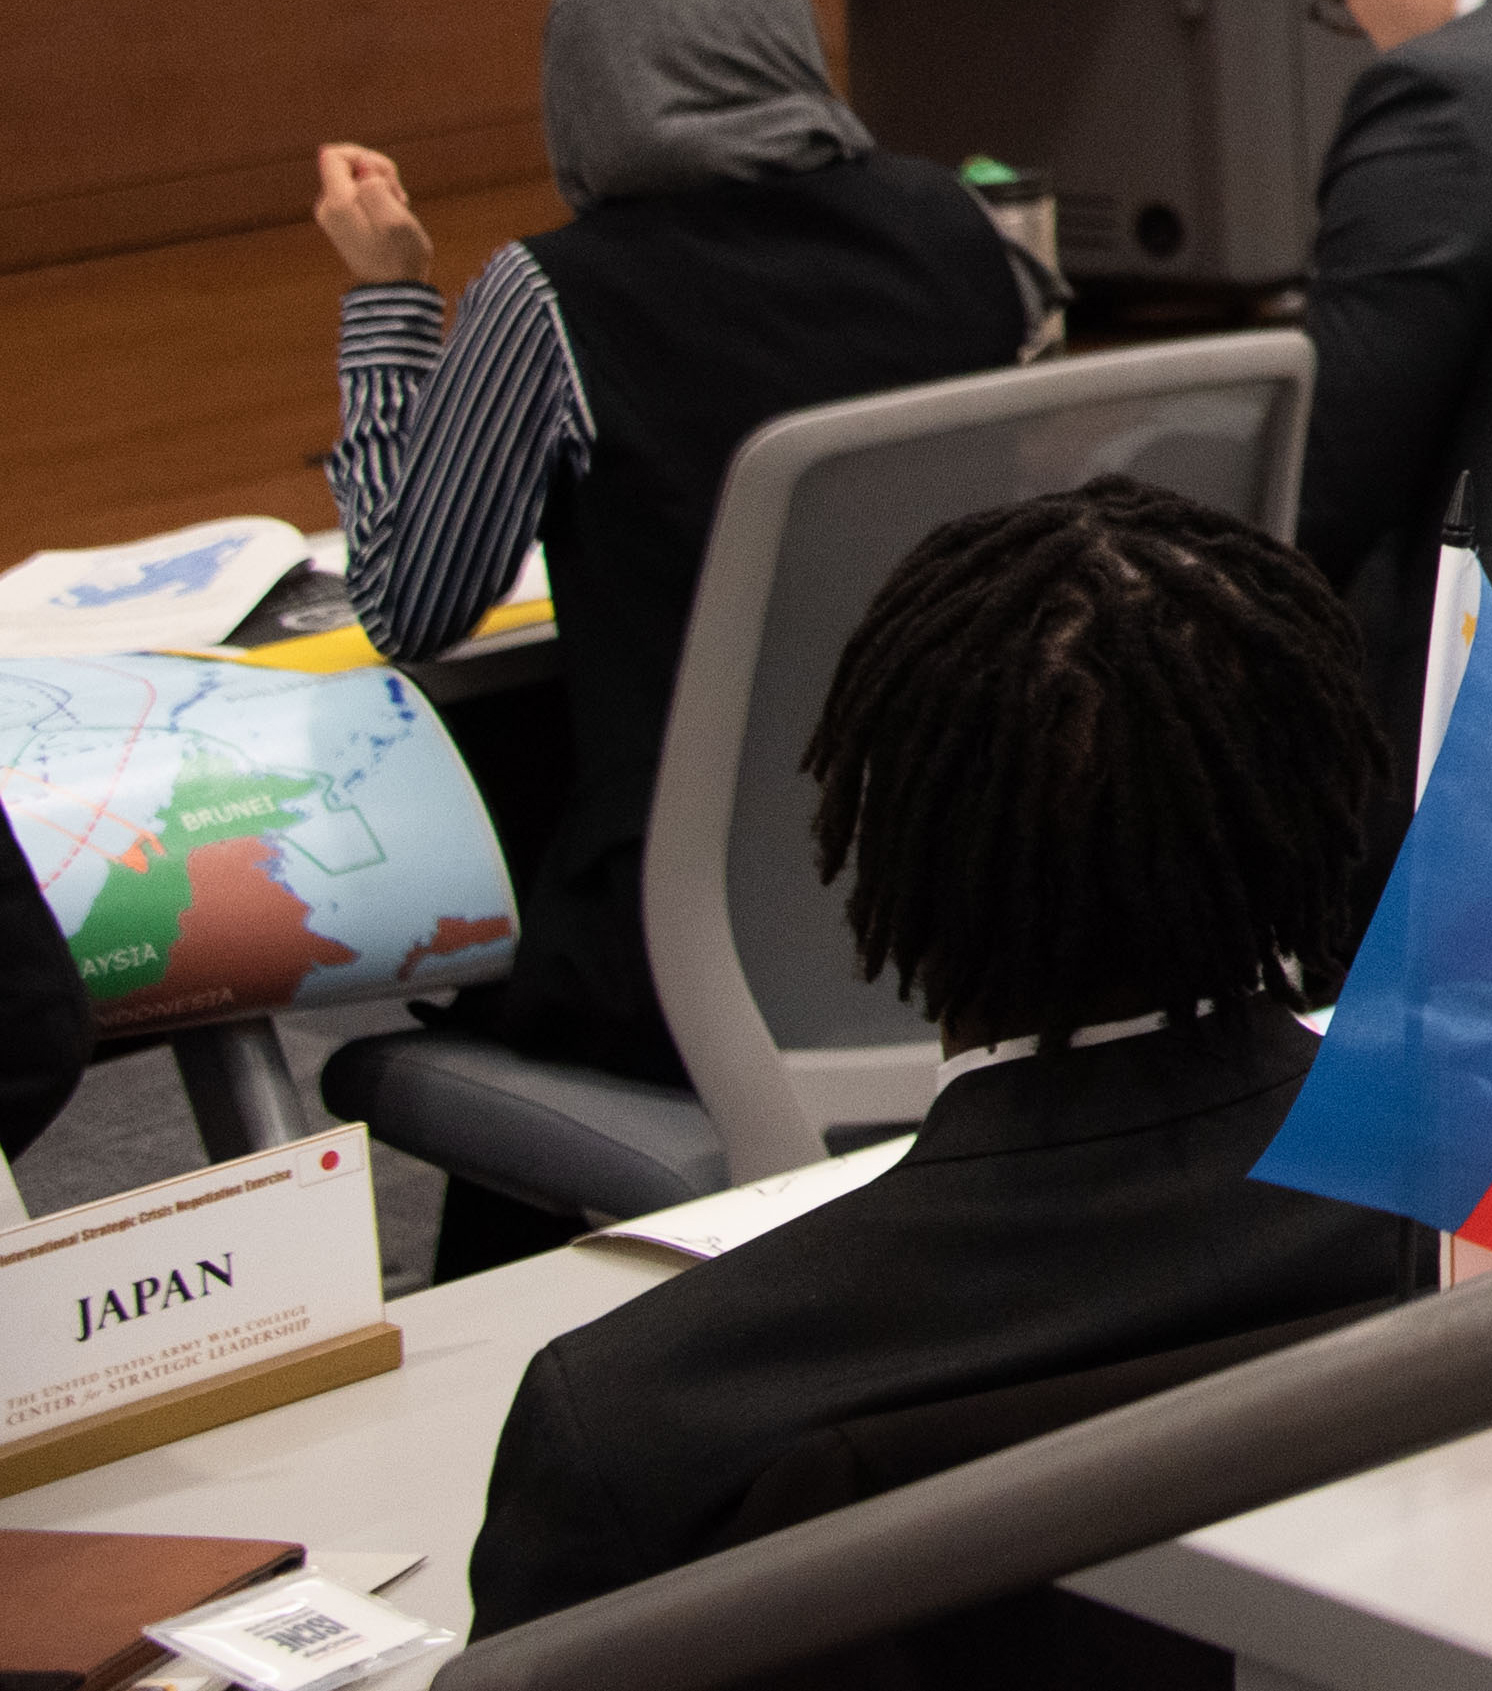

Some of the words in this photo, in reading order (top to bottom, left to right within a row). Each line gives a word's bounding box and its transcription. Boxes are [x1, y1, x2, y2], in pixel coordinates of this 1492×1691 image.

[180, 794, 277, 834] BRUNEI
[81, 1216, 137, 1242] Strategic
[138, 1204, 174, 1224] Crisis
[175, 1183, 244, 1214] Negotiation
[245, 1169, 293, 1193] Exercise
[76, 1251, 234, 1343] JAPAN
[5, 1394, 77, 1427] CENTER
[107, 1350, 203, 1393] STRATEGIC
[208, 1317, 312, 1362] LEADERSHIP
[7, 1393, 35, 1411] THE
[42, 1372, 100, 1399] UNITED
[104, 1354, 155, 1378] STATES
[161, 1338, 202, 1359] ARMY
[207, 1326, 241, 1344] WAR
[247, 1305, 308, 1332] COLLEGE
